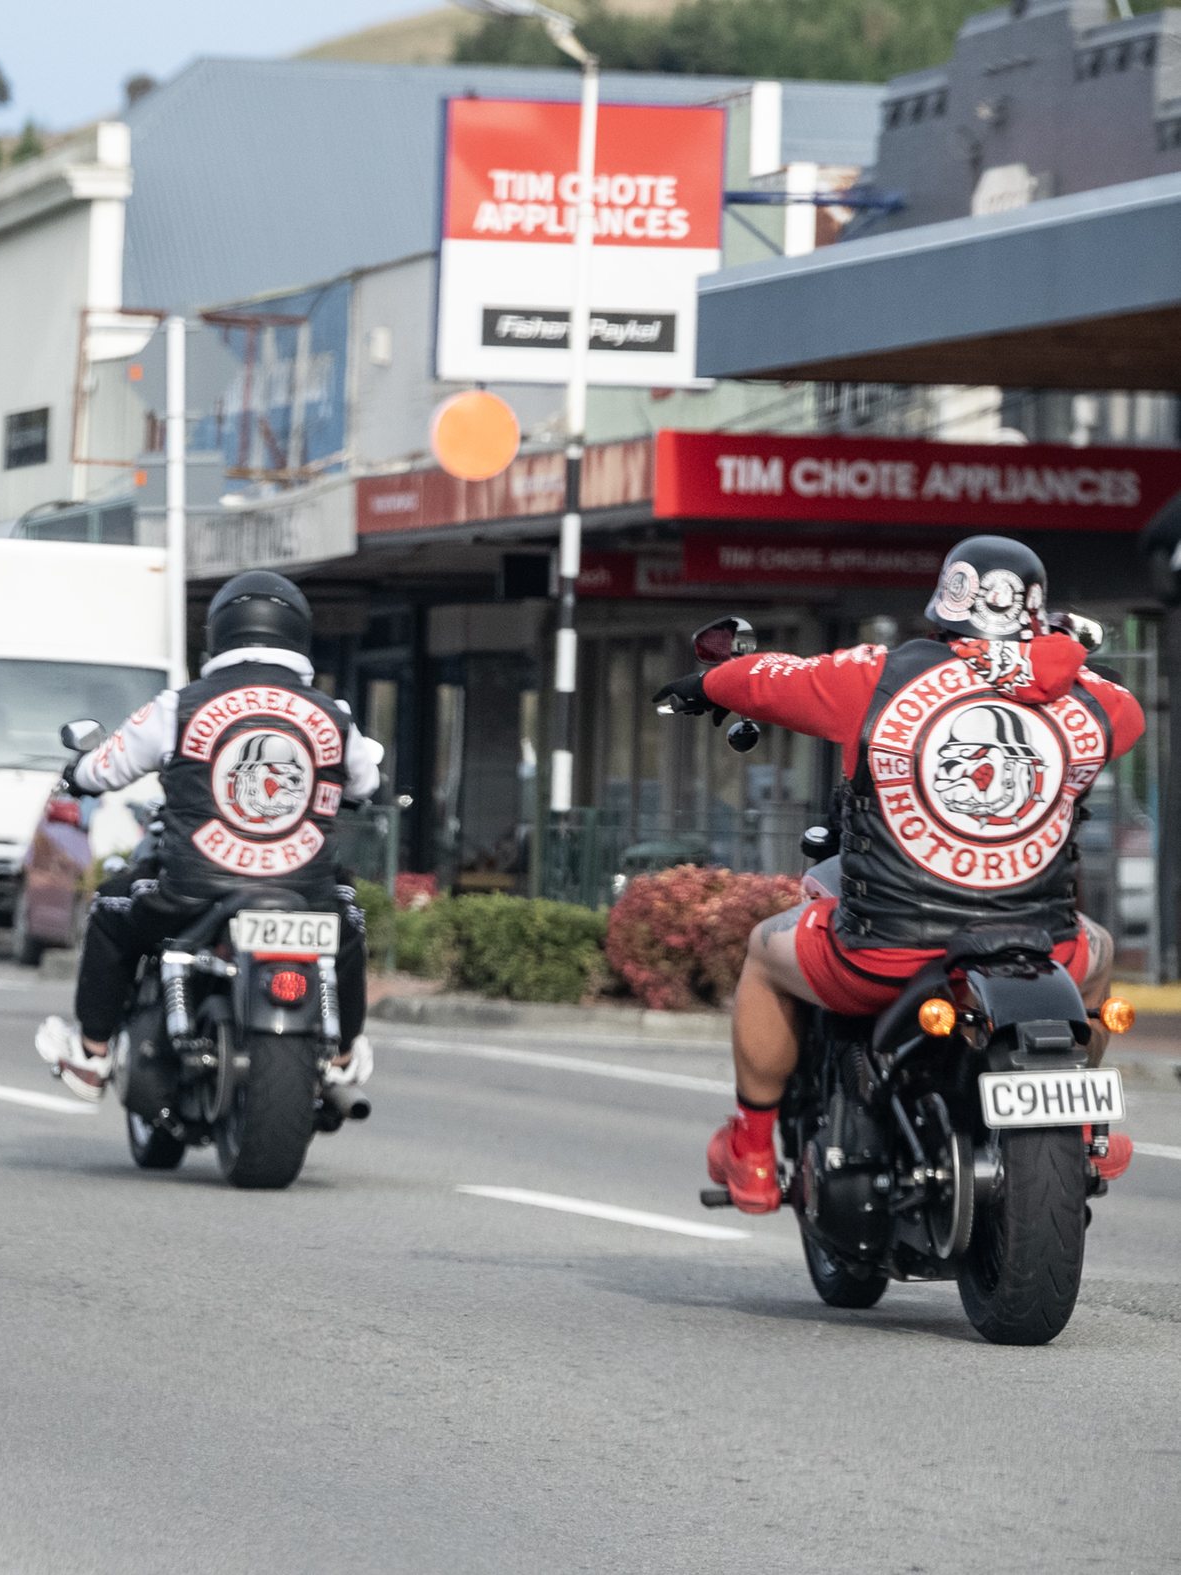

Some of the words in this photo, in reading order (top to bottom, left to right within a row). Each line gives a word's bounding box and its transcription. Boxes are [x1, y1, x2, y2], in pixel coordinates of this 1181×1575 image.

[488, 169, 555, 202] TIM
[558, 172, 678, 206] CHOTE
[717, 455, 784, 496] TIM
[790, 457, 918, 499] CHOTE
[920, 461, 1140, 507] APPLIANCES
[186, 690, 298, 755] MONGREL
[302, 711, 340, 764] MOB
[879, 664, 983, 746] MONG
[204, 830, 317, 870] RIDERS
[992, 1079, 1113, 1116] C9HHW
